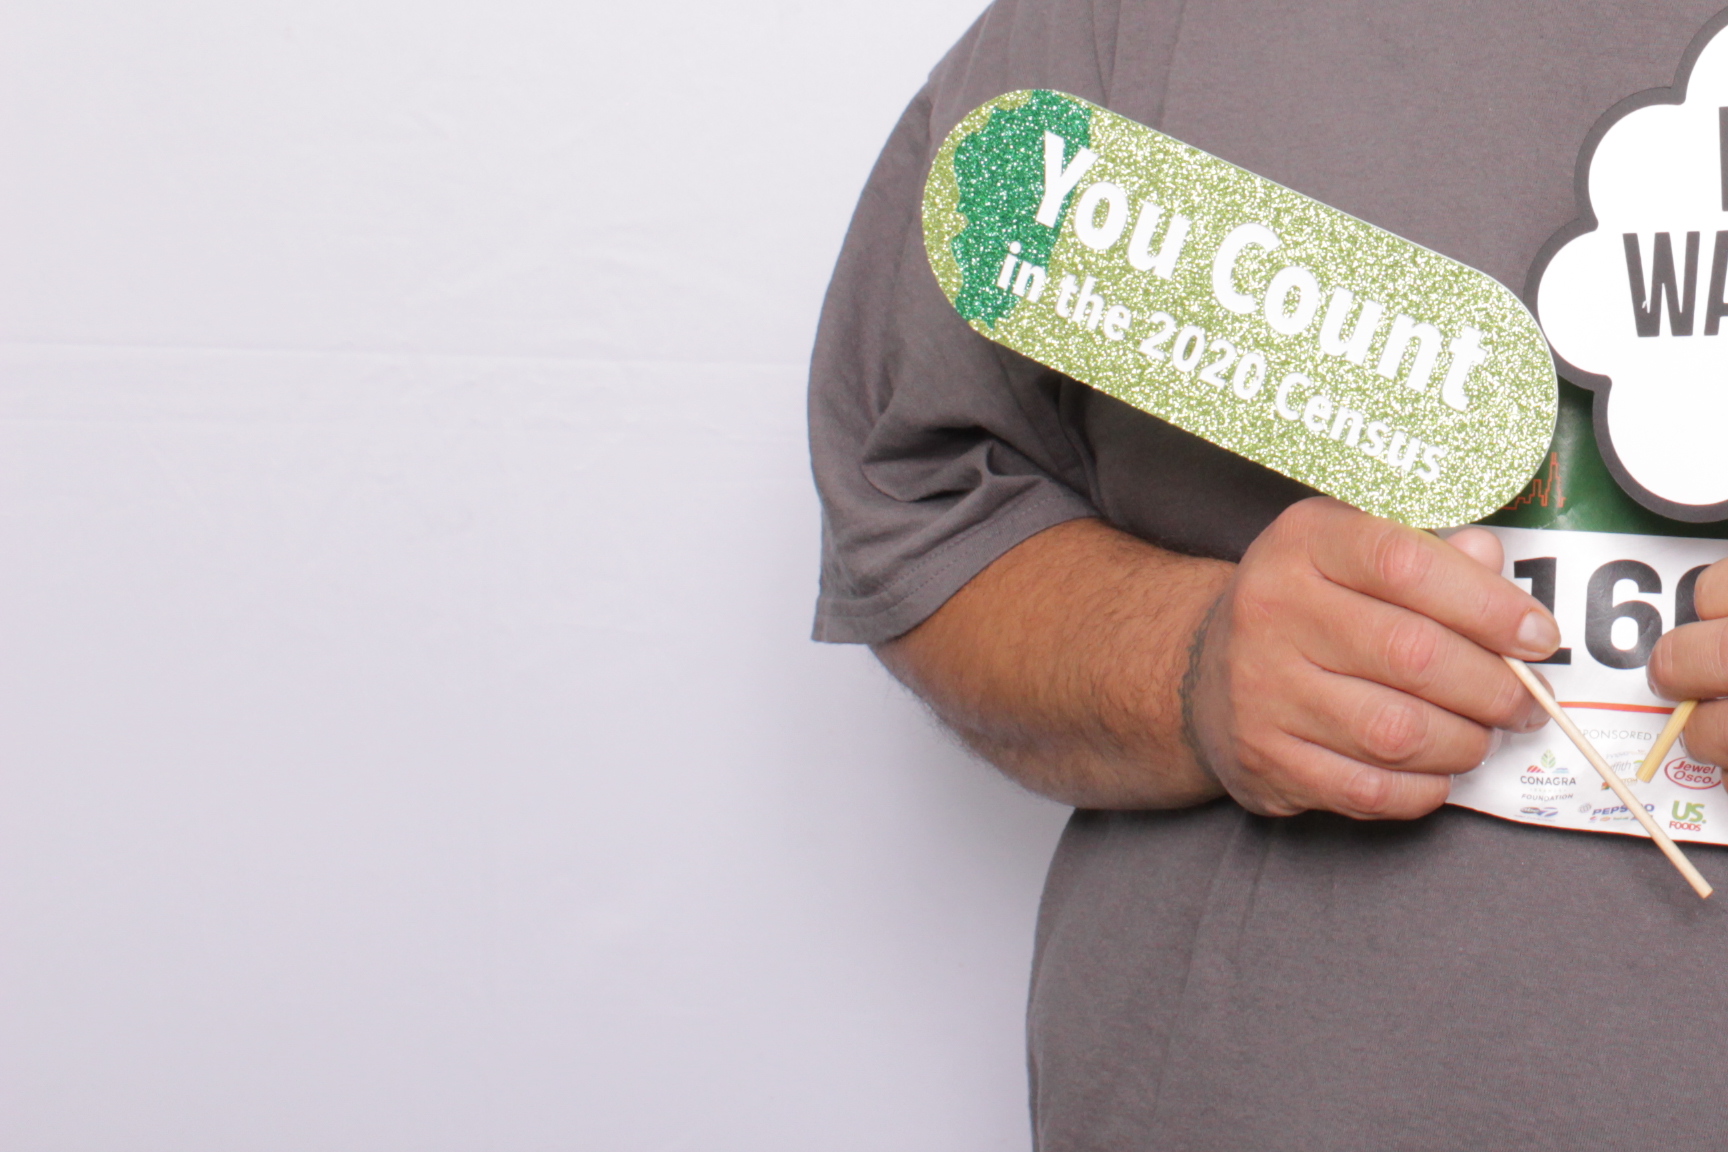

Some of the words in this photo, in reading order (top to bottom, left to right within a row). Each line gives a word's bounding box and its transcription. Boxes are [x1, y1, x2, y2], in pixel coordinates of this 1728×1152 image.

[1035, 129, 1191, 281] You
[1211, 222, 1488, 412] Count
[997, 241, 1047, 305] in
[1054, 271, 1132, 342] the
[1138, 310, 1267, 401] 2020
[1275, 371, 1448, 483] Census
[1582, 728, 1653, 742] PONSORED
[1673, 760, 1717, 775] Jewel
[1519, 775, 1577, 786] CONAGRA
[1521, 793, 1575, 803] FOUNDATION
[1592, 803, 1656, 816] PEPSO
[1669, 820, 1702, 832] FOODS
